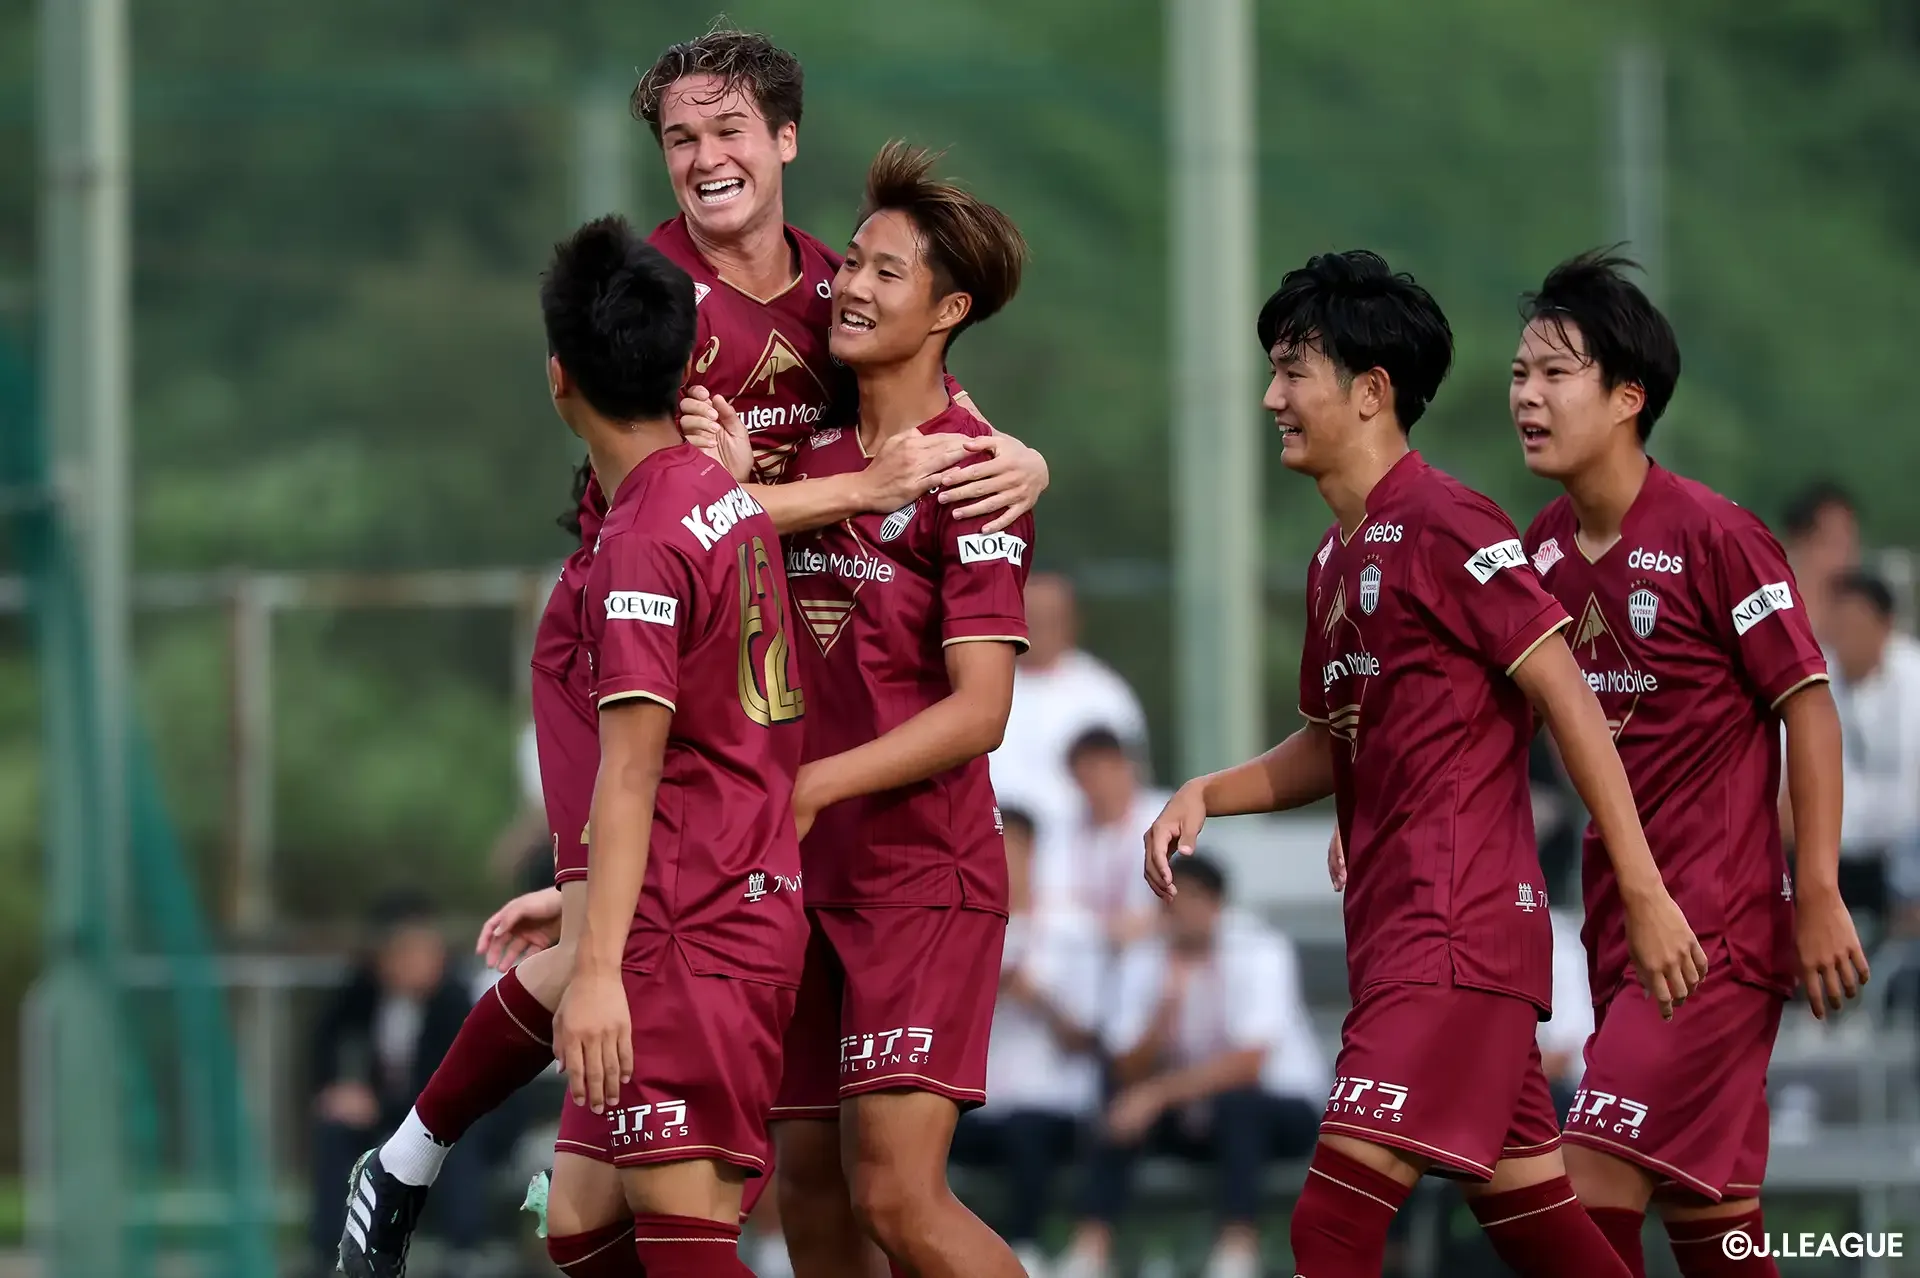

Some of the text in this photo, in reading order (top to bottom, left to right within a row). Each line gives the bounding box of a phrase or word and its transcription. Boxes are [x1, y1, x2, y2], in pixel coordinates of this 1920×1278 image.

[738, 405, 786, 430] uten
[1364, 521, 1404, 543] debs
[830, 553, 896, 583] Mobile
[1628, 547, 1683, 574] debs
[610, 597, 671, 620] OEVIR
[1607, 669, 1658, 693] Mobile
[610, 1125, 688, 1147] LDINGS
